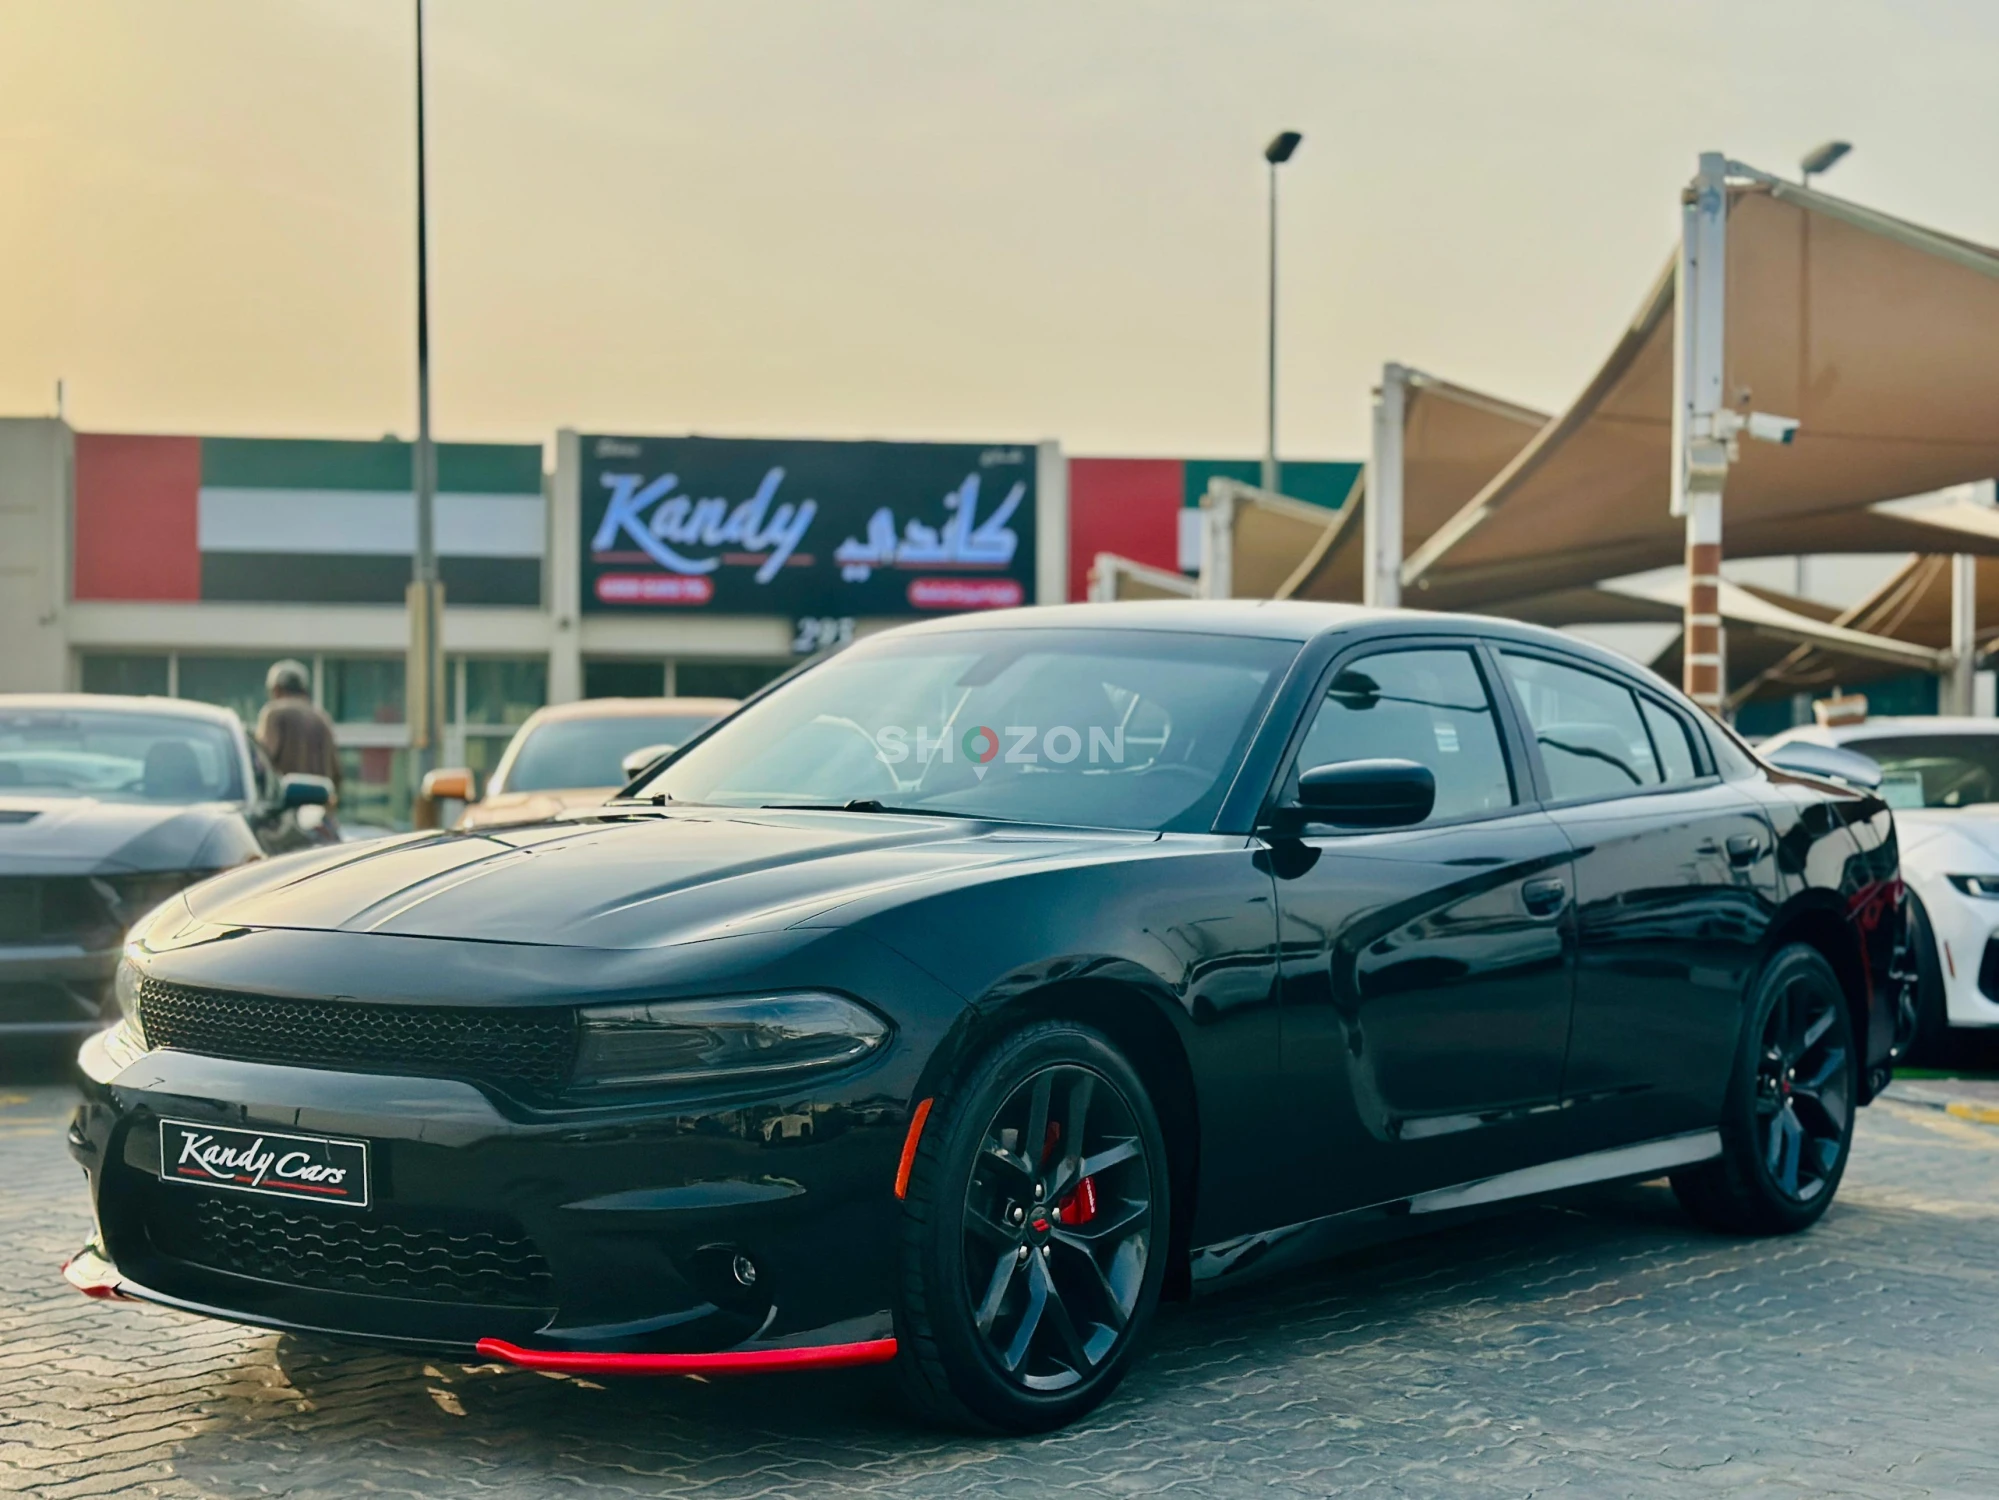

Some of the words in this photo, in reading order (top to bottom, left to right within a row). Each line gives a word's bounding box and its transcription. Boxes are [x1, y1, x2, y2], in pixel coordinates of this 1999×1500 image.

[591, 466, 817, 584] Kandy
[834, 472, 1027, 583] كاندي
[178, 1131, 276, 1187] Kandy
[274, 1151, 348, 1185] Cars
